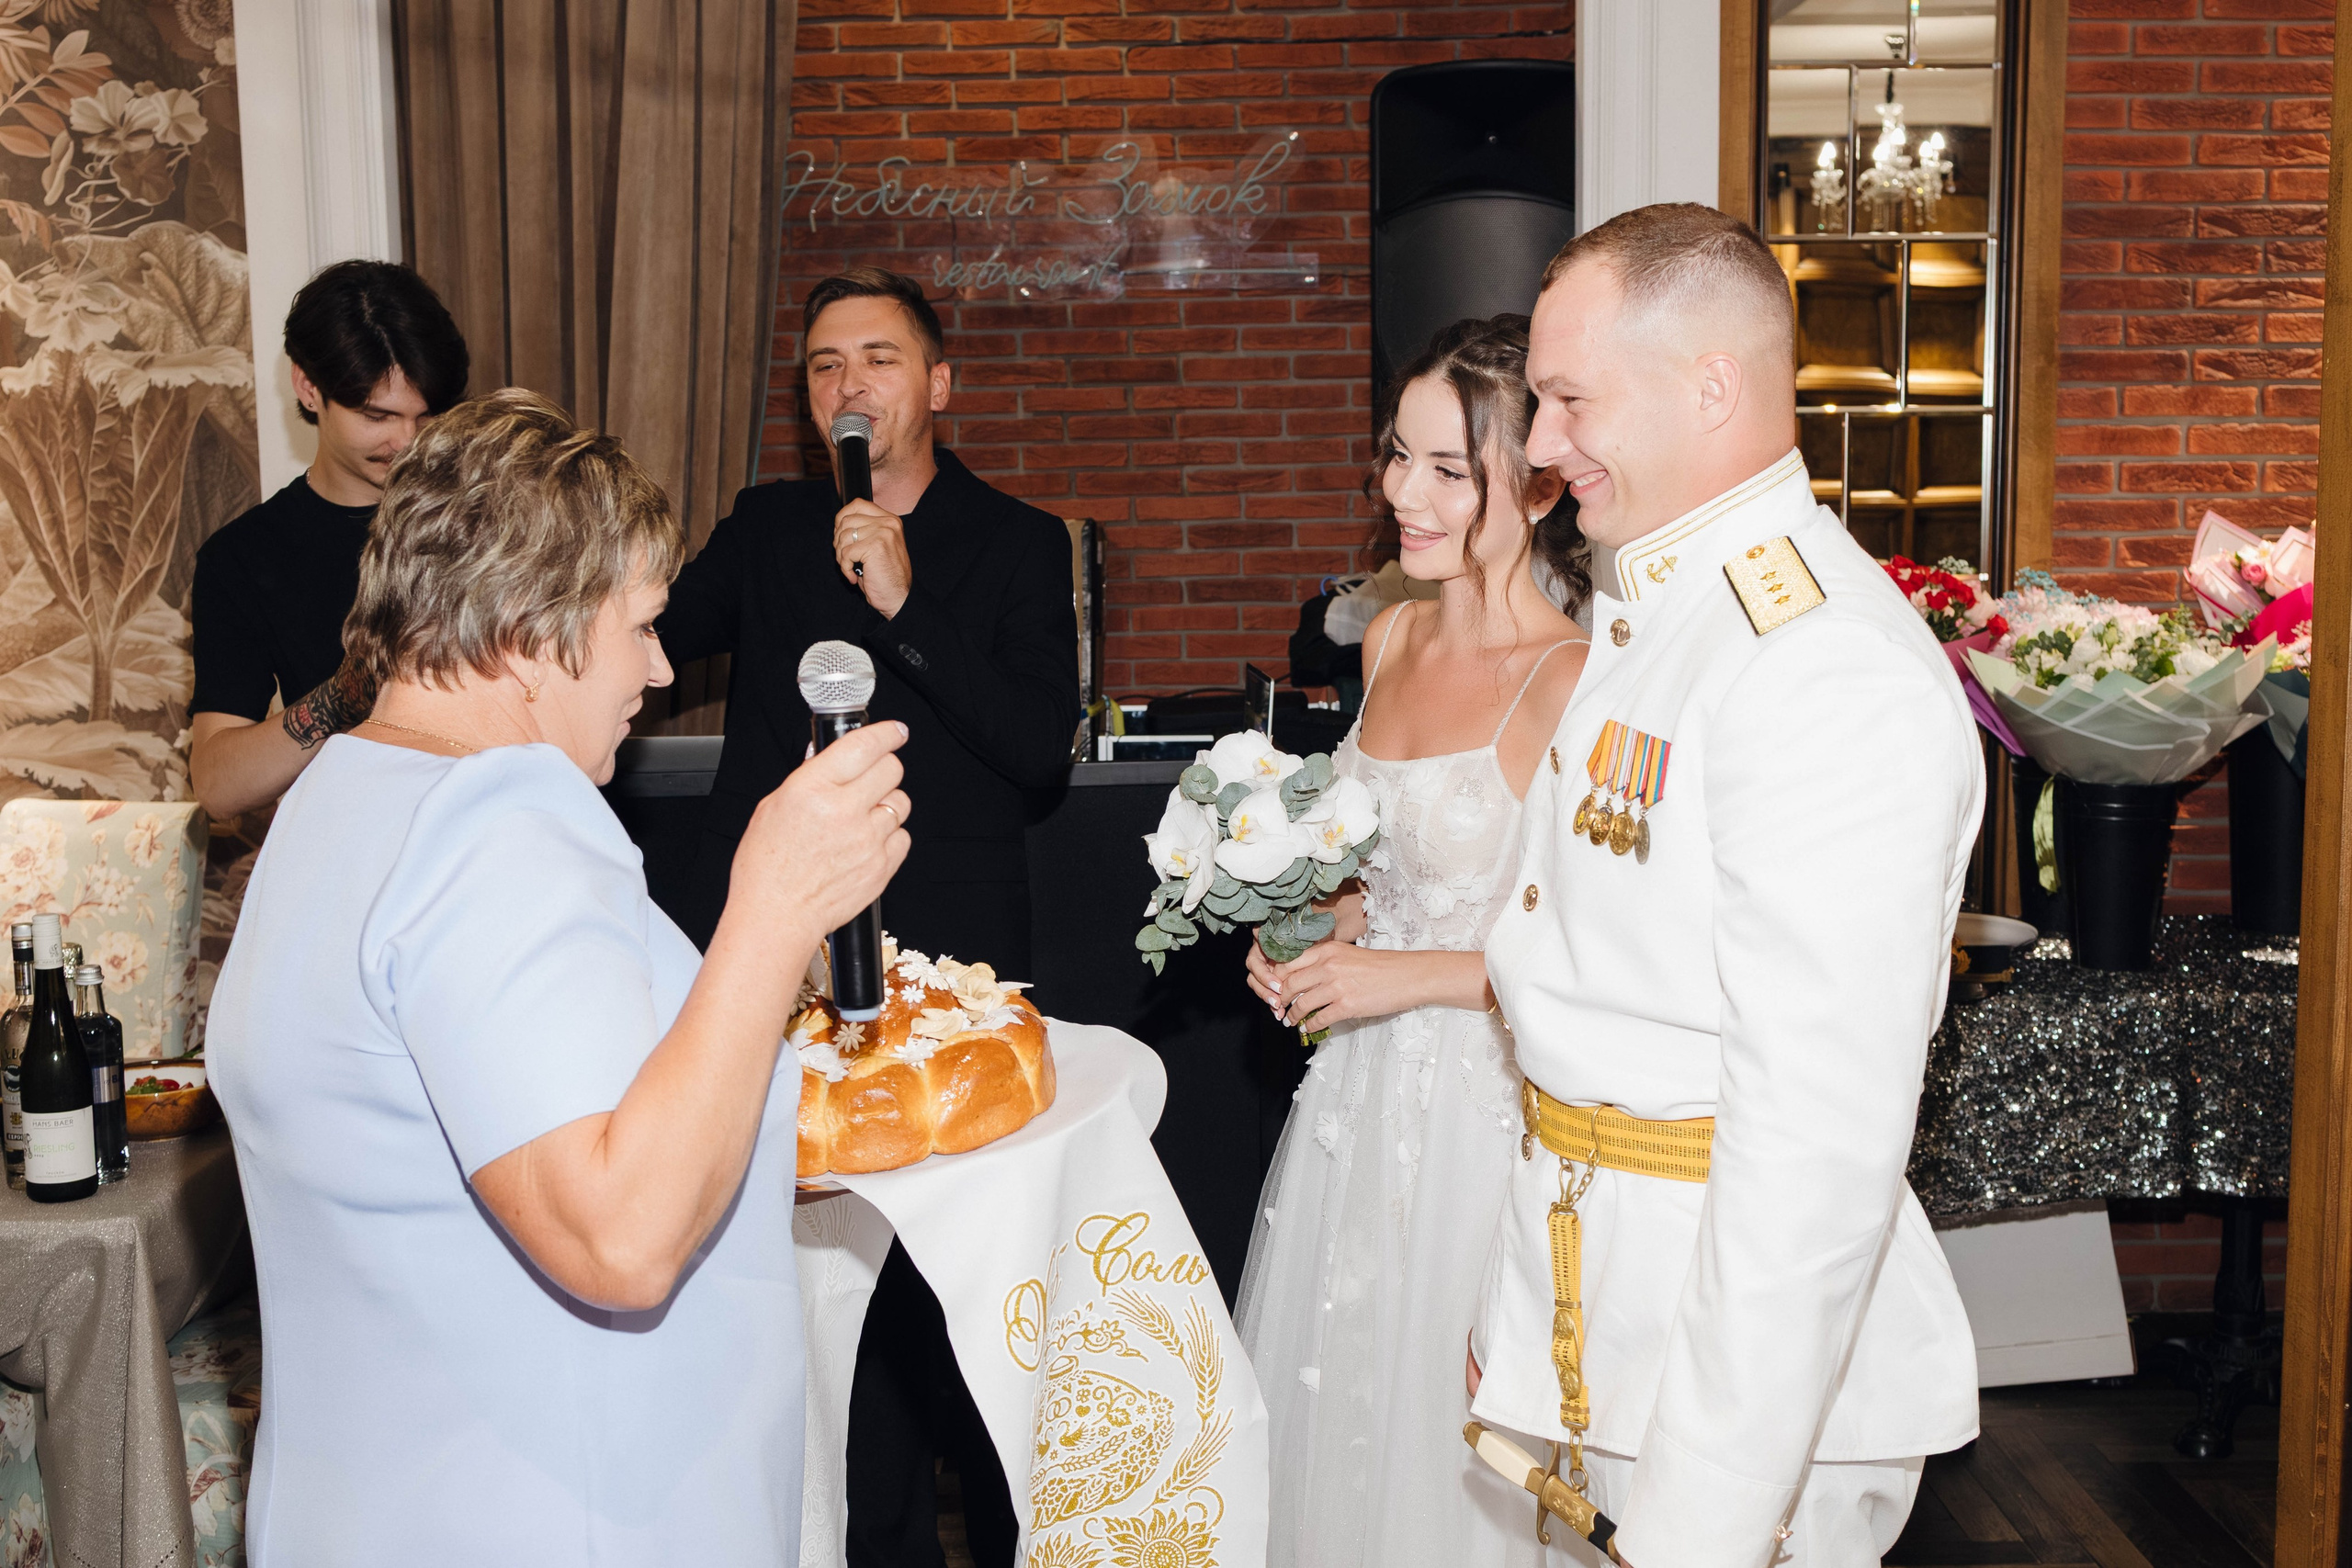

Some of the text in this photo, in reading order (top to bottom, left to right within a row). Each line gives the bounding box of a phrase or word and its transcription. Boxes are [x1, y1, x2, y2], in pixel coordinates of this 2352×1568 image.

[779, 141, 1291, 233] Небесный Замок
[932, 242, 1128, 291] restaurant
[32, 1118, 74, 1128] HANS BAER
[33, 1142, 75, 1154] RIESLING
[1074, 1211, 1210, 1297] Соль
